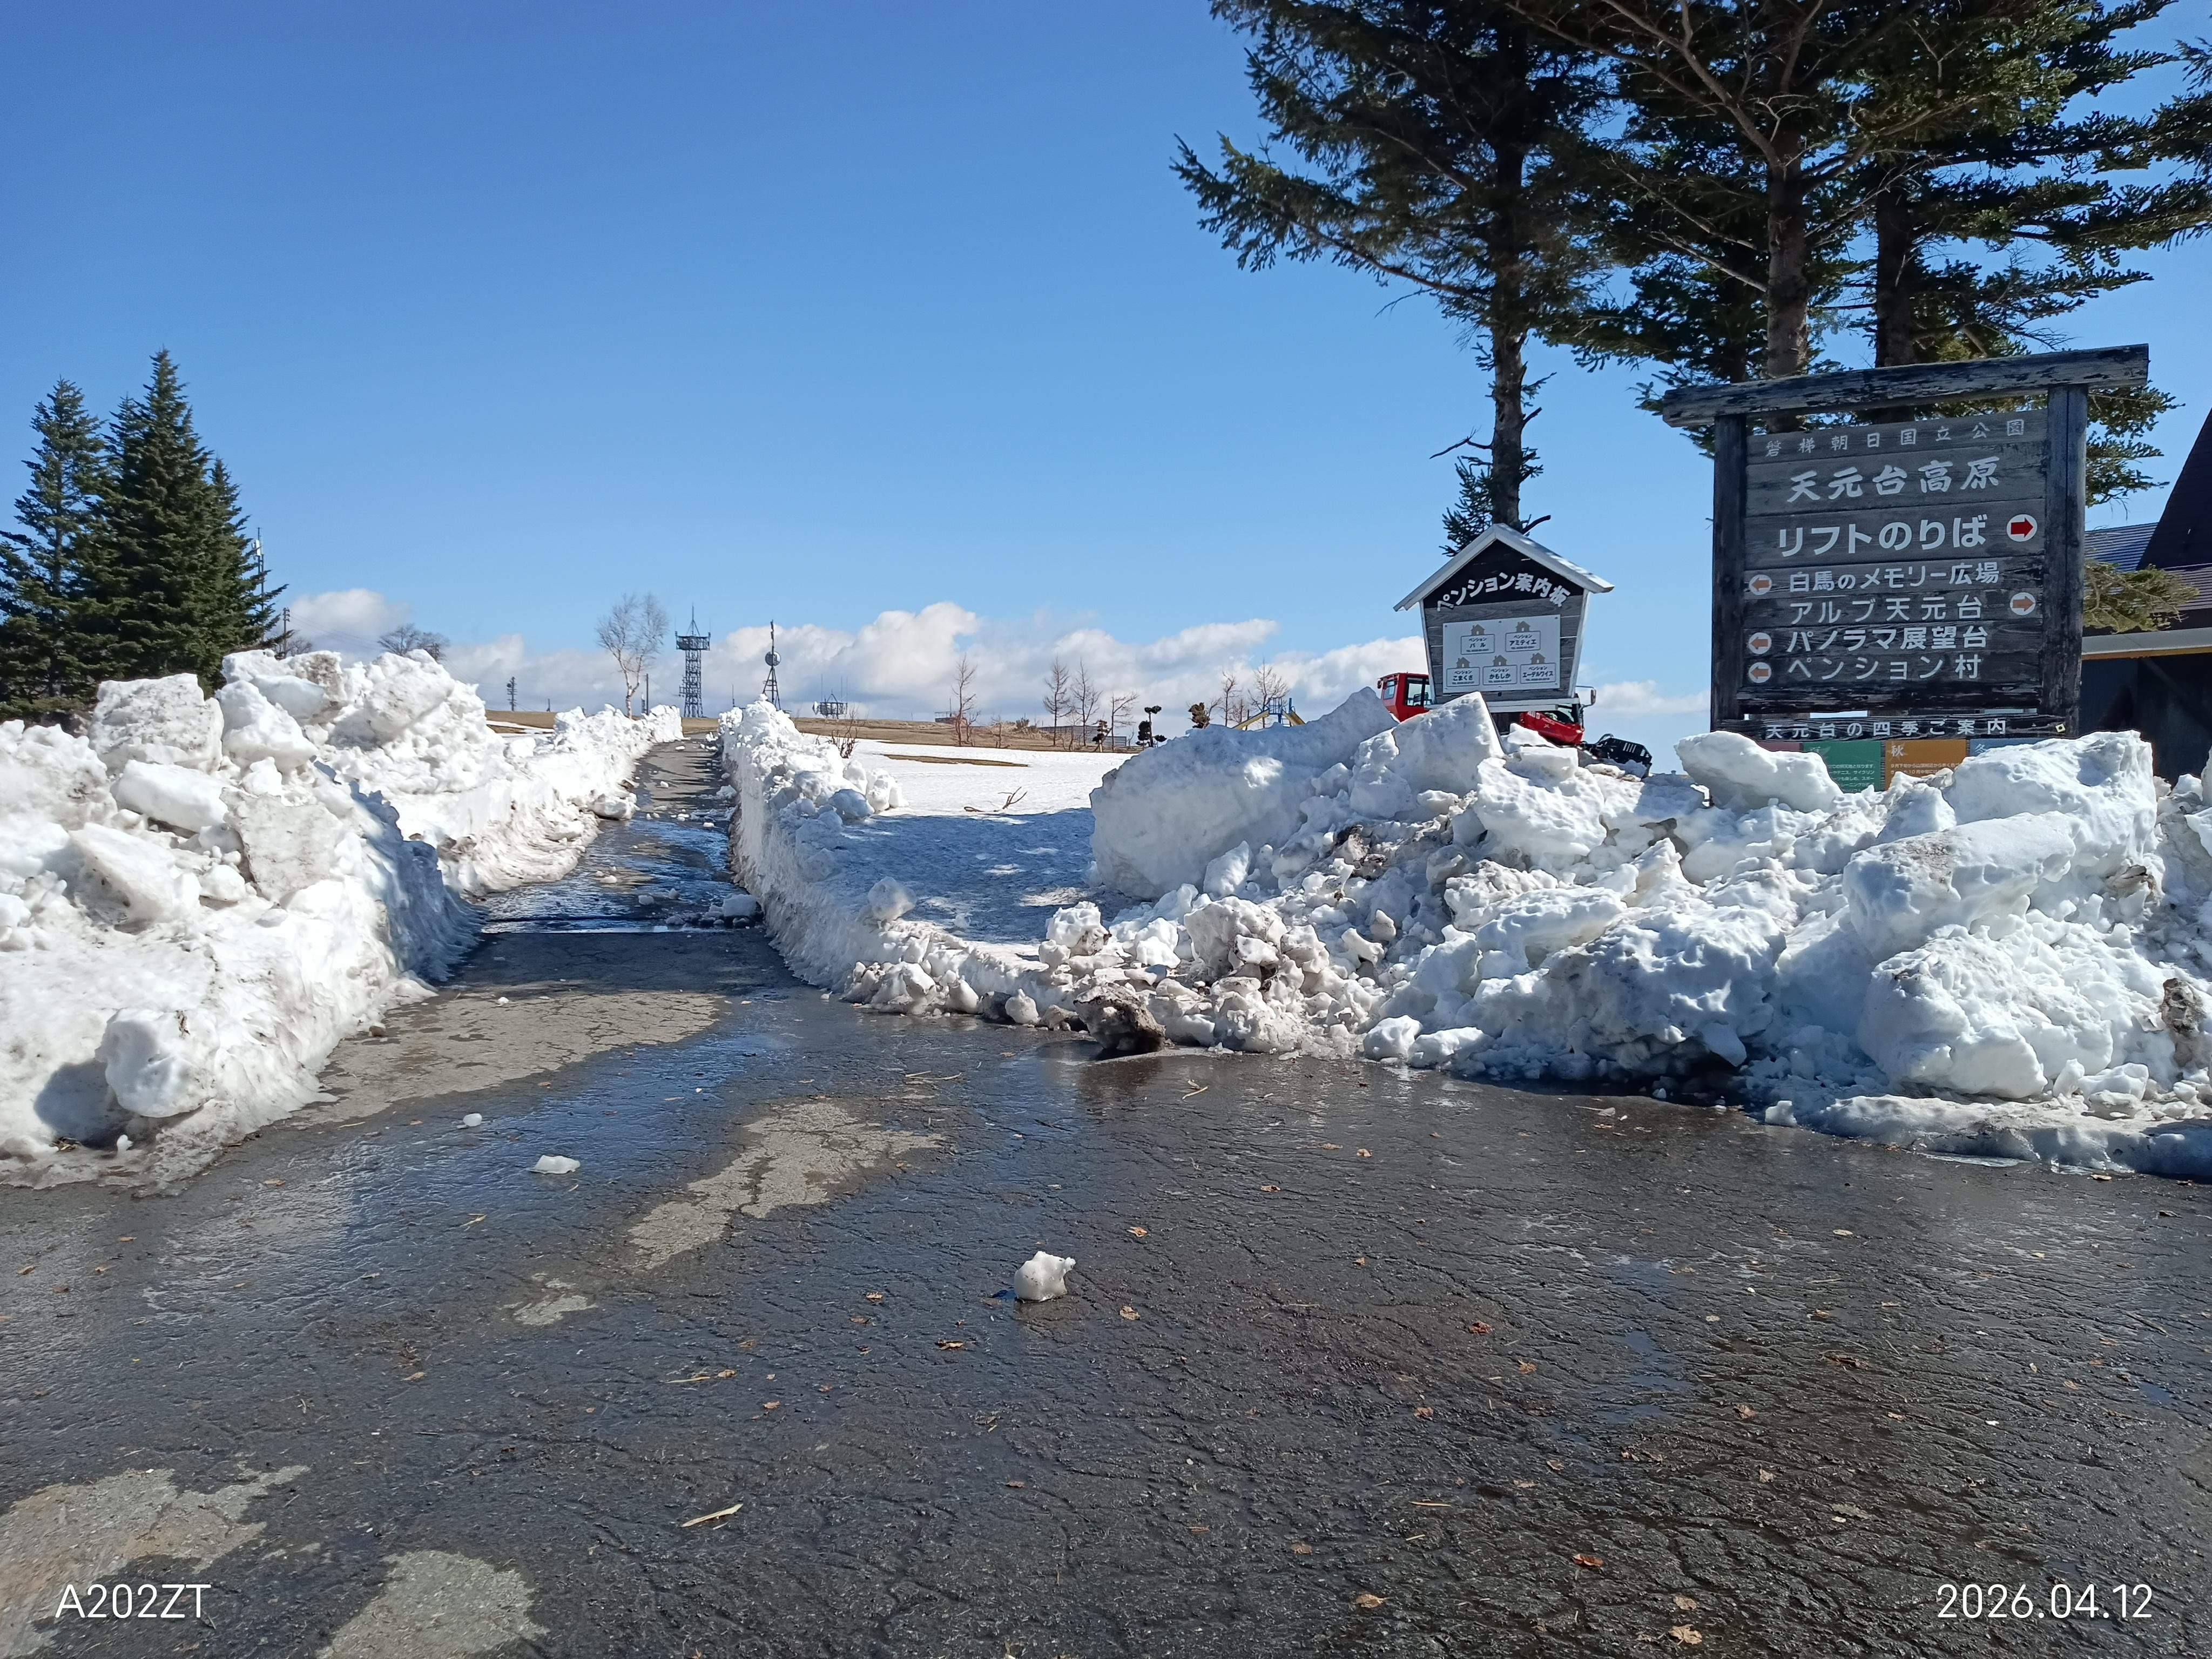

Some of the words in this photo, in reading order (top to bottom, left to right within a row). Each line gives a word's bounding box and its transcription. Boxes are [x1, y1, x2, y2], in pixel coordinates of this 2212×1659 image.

[1766, 419, 2025, 457] 磐梯朝日国立公園
[1786, 456, 2000, 503] 天元台高原
[1779, 514, 1988, 557] リフトのりば
[1437, 572, 1571, 612] ペンション案内板
[1790, 562, 1999, 592] 白馬のメモリー広場
[1790, 595, 1982, 625] アルブ天元台
[1786, 625, 1988, 652] パノラマ展望台
[1788, 654, 1982, 680] ペンション村
[1766, 718, 2007, 739] 天元台の四季ご案内
[1891, 745, 1904, 757] 秋
[1974, 743, 1987, 754] 冬
